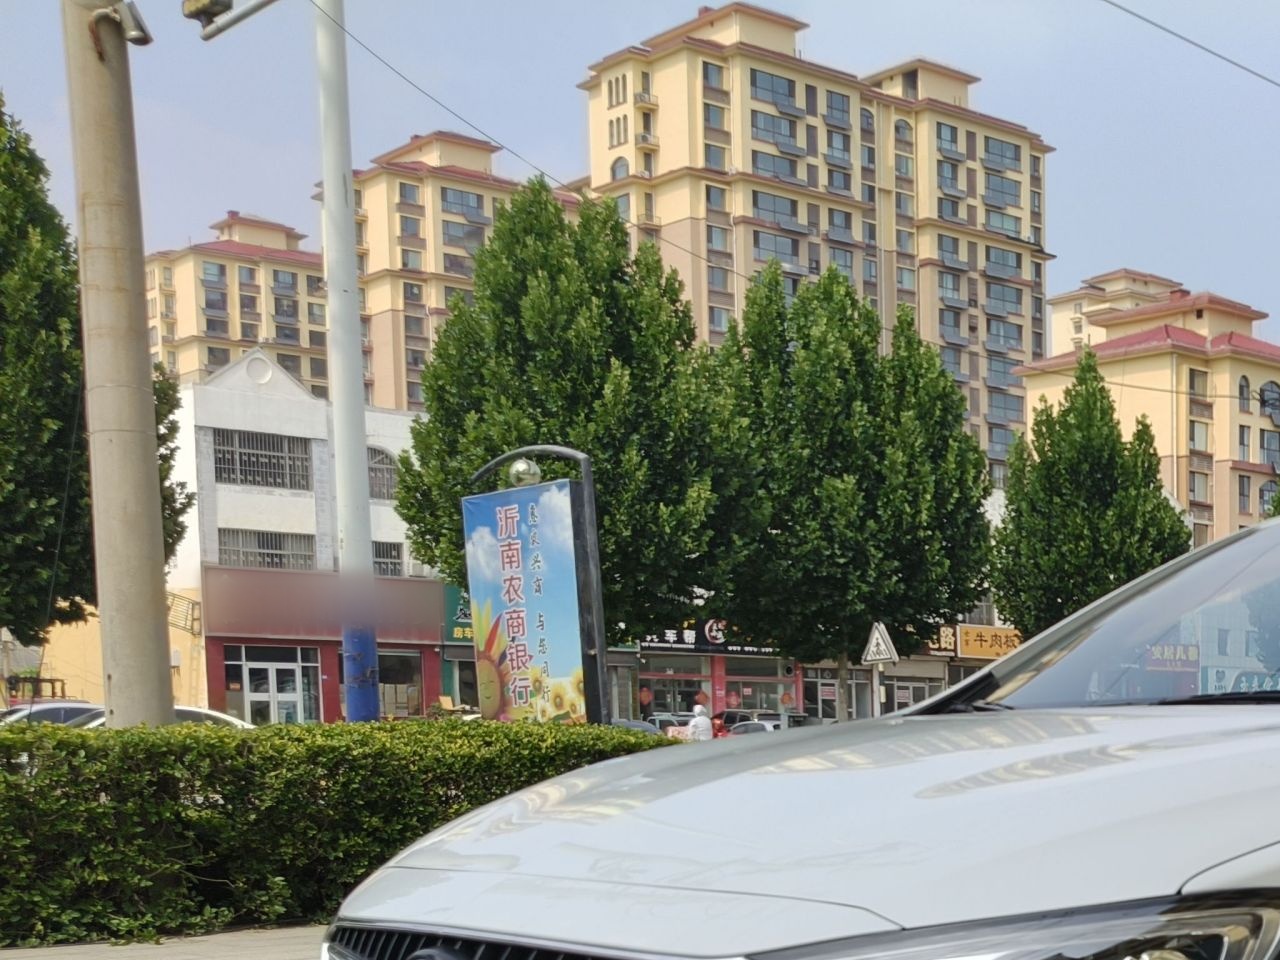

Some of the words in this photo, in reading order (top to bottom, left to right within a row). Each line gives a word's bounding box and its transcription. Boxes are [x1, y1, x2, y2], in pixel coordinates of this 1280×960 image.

[496, 504, 532, 707] 沂南农商银行
